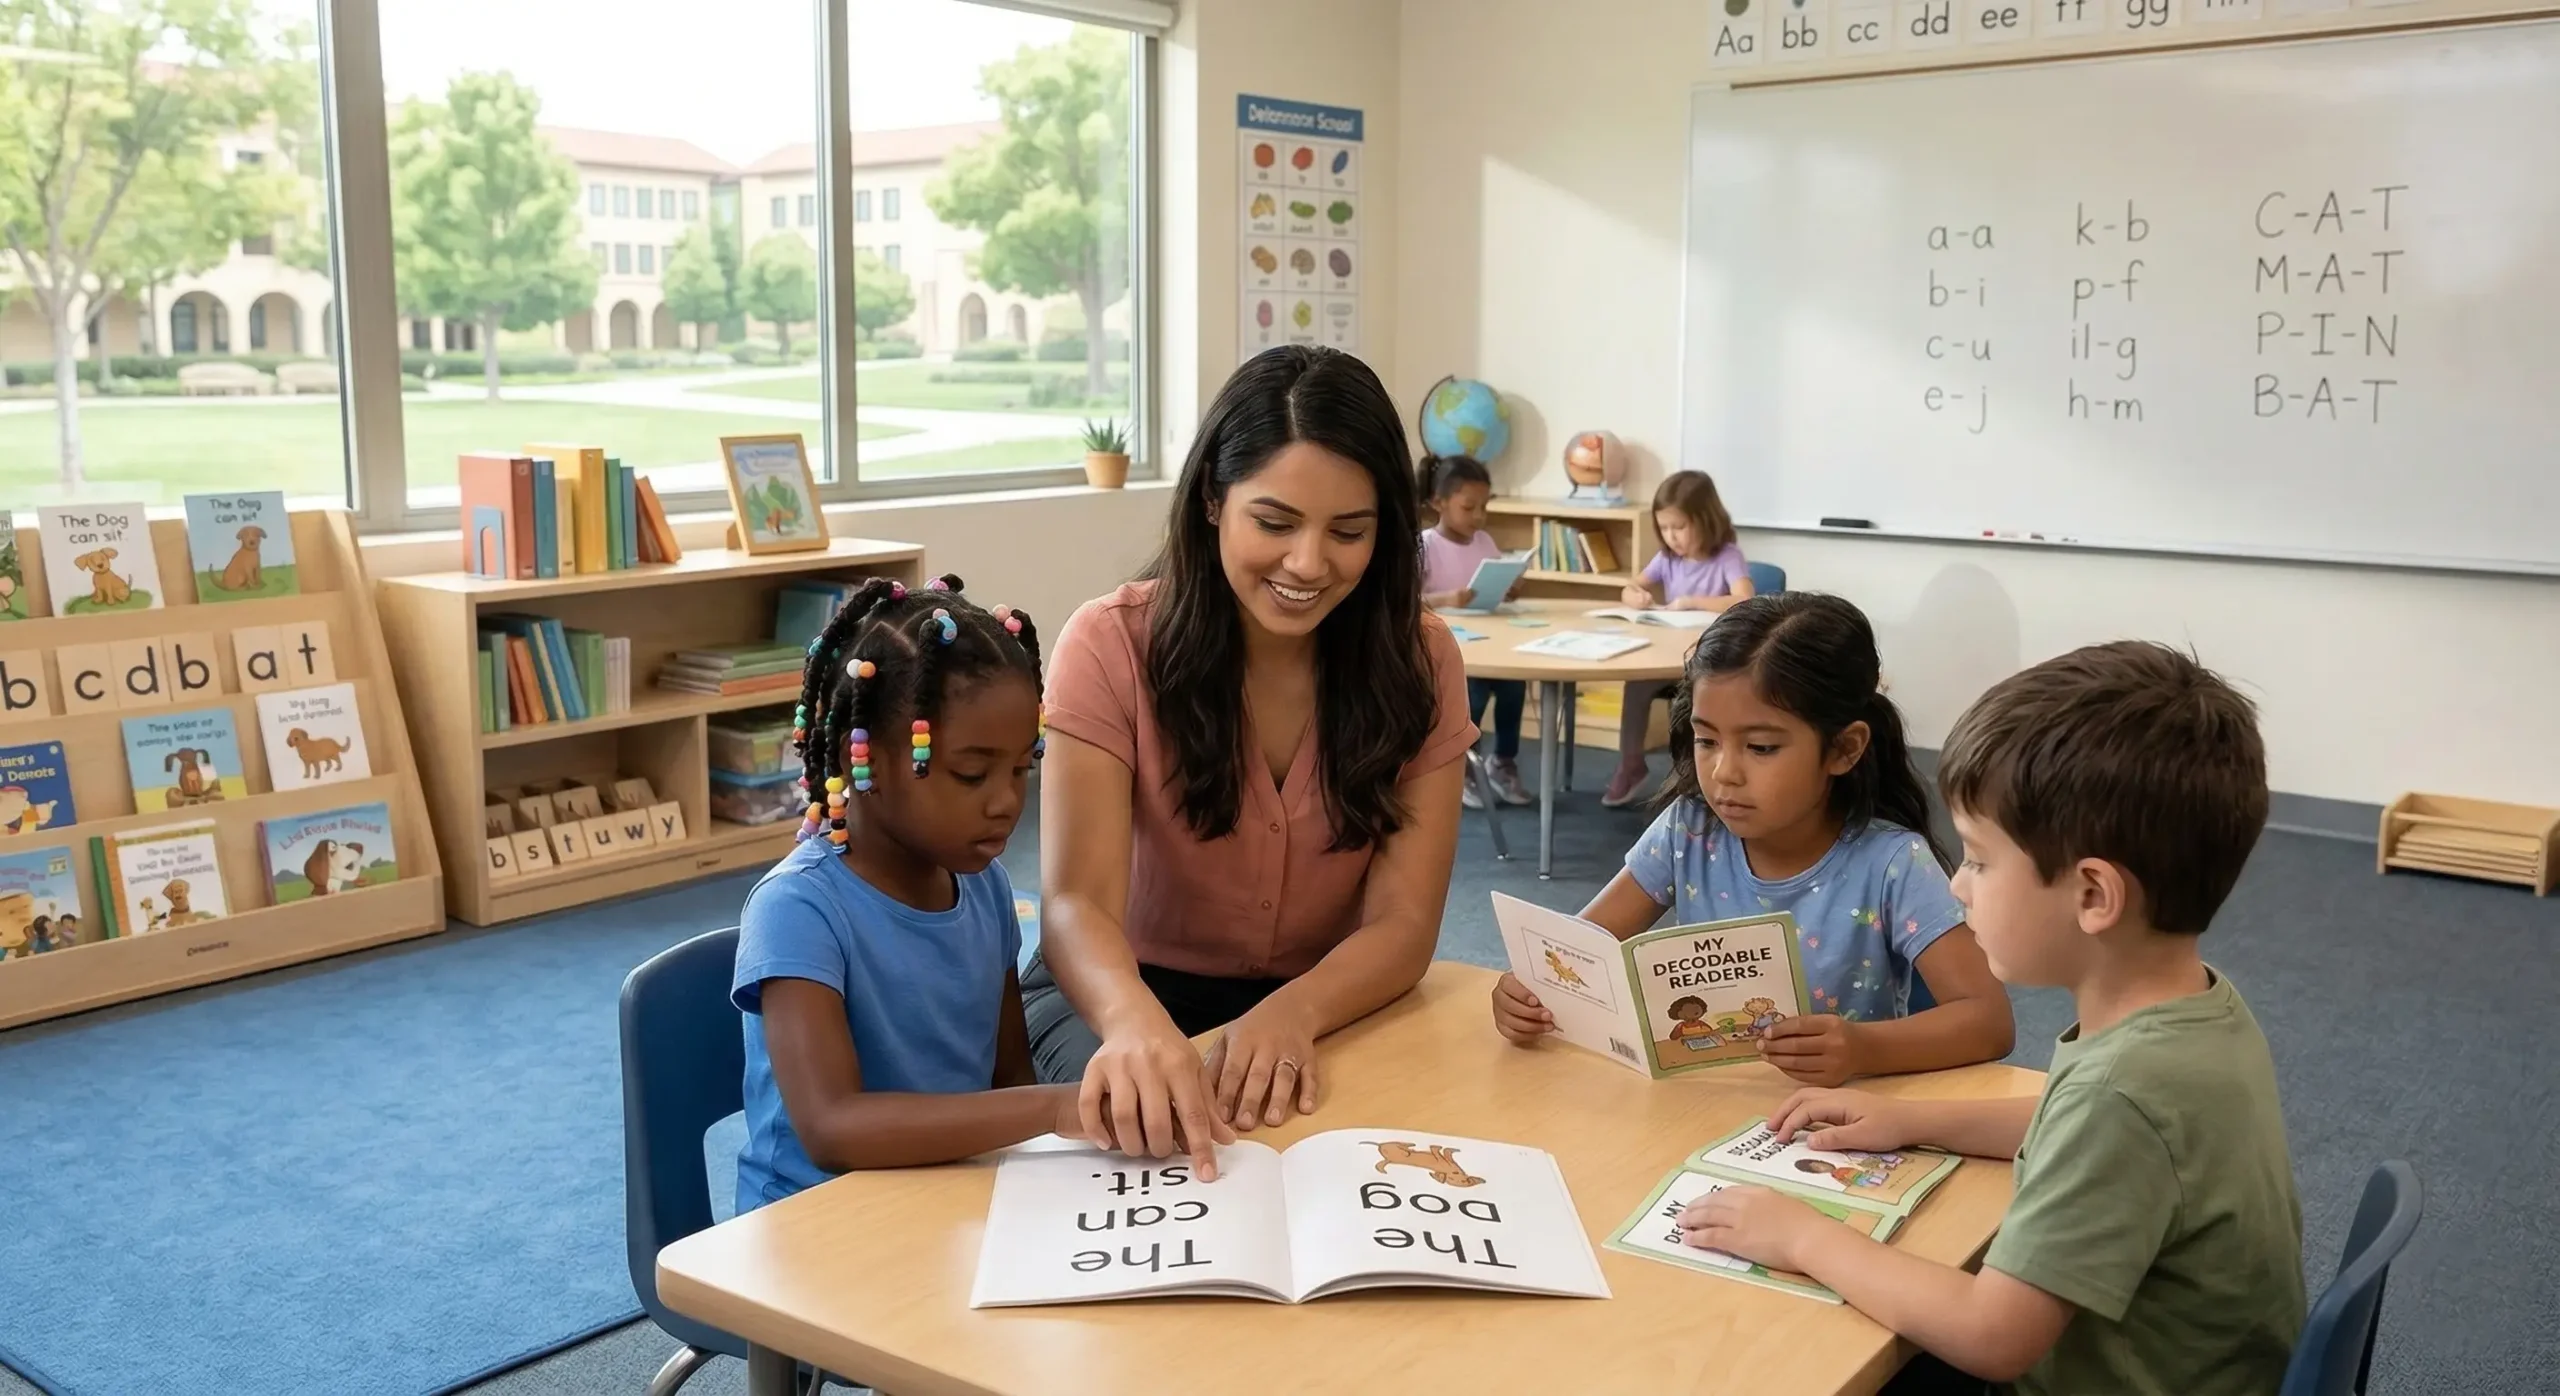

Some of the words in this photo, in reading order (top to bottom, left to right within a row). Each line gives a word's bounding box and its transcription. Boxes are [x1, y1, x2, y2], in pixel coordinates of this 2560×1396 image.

[1715, 25, 1753, 56] Aa
[1783, 16, 1817, 48] bb
[1848, 22, 1878, 43] cc
[1911, 1, 1949, 36] dd
[1981, 8, 2018, 29] ee
[2126, 0, 2169, 29] gg
[2077, 200, 2149, 245] k-b
[2256, 186, 2408, 238] C-A-T
[1928, 225, 1993, 250] a-a
[1930, 269, 1984, 307] b-i
[2073, 259, 2144, 320] p-f
[2256, 250, 2403, 293] M-A-T
[1927, 336, 1991, 360] c-u
[2258, 312, 2397, 357] P-I-N
[1924, 385, 1987, 434] e-j
[2069, 377, 2143, 421] h-m
[2255, 374, 2397, 423] B-A-T
[59, 515, 89, 527] The
[96, 514, 129, 530] Dog
[69, 530, 98, 544] can
[489, 847, 506, 868] b
[528, 845, 539, 859] s
[562, 833, 574, 854] t
[661, 815, 674, 837] y
[1653, 947, 1772, 976] DECODABLE
[1694, 937, 1723, 953] MY
[1669, 965, 1764, 989] READERS.
[1090, 1165, 1190, 1196] sit.
[1078, 1201, 1208, 1231] can
[1360, 1182, 1501, 1224] Dog
[1071, 1240, 1212, 1272] The
[1373, 1228, 1517, 1269] The
